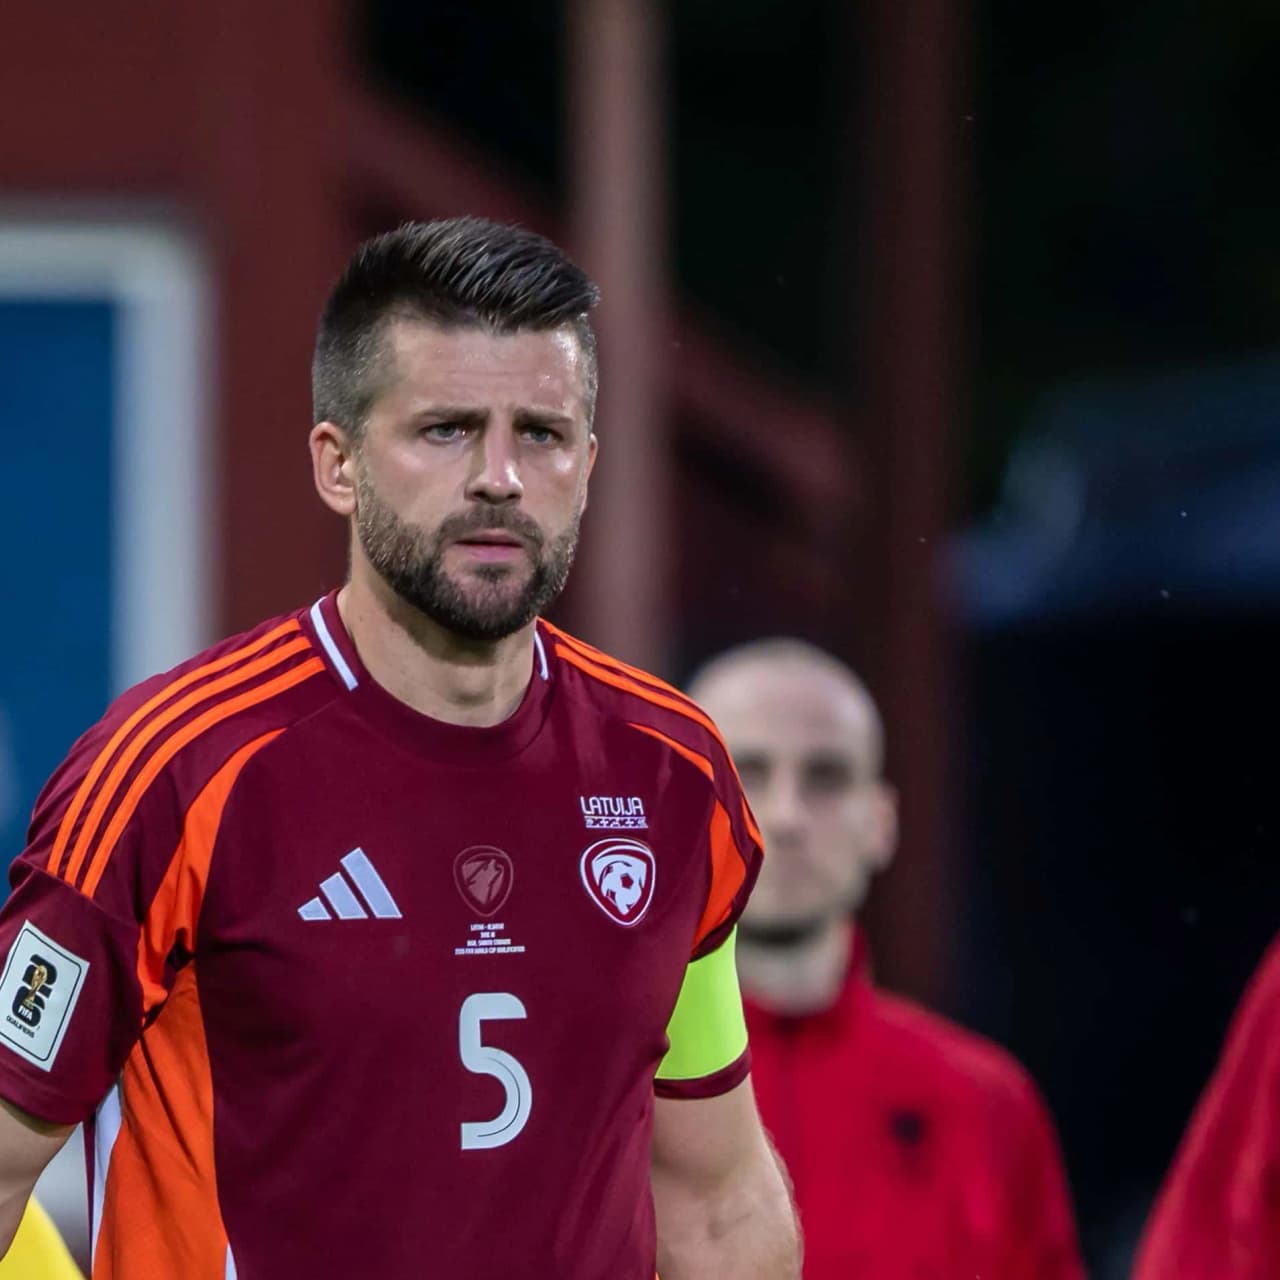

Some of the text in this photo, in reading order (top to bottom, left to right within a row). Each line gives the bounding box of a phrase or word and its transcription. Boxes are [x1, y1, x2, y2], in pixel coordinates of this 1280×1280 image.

[17, 1005, 34, 1021] FIFA
[6, 1015, 35, 1038] QUALIFIERS
[459, 992, 533, 1150] 5
